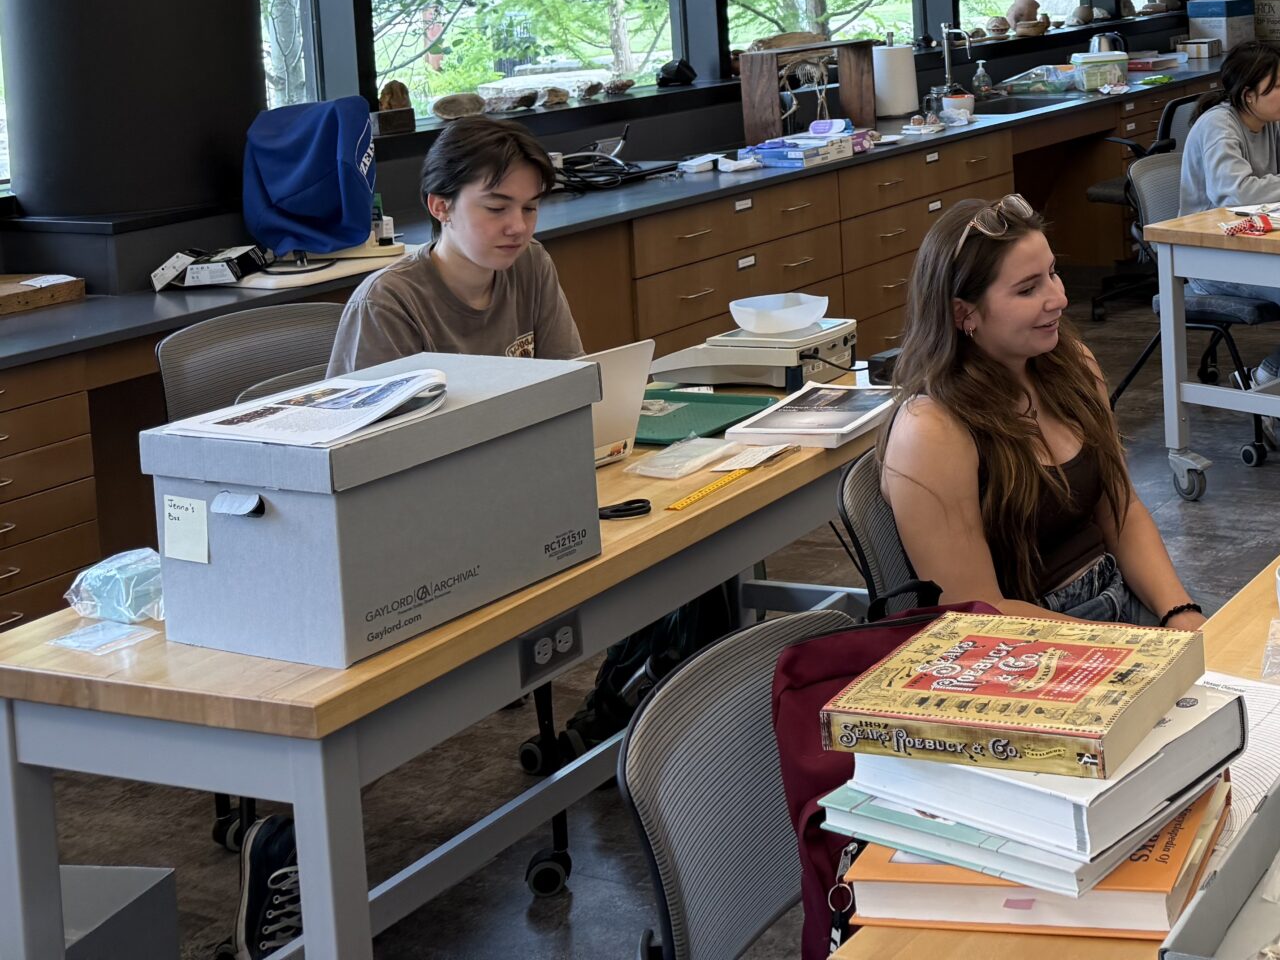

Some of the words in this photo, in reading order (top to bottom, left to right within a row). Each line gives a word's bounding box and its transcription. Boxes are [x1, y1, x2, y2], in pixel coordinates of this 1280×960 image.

[544, 529, 587, 554] RC121510
[365, 594, 414, 623] GAYLORD
[366, 613, 422, 642] Gaylord.com
[930, 641, 1022, 692] ROEBUCK
[839, 722, 893, 748] SEARS
[893, 726, 973, 756] ROEBUCK
[859, 720, 889, 729] 1897
